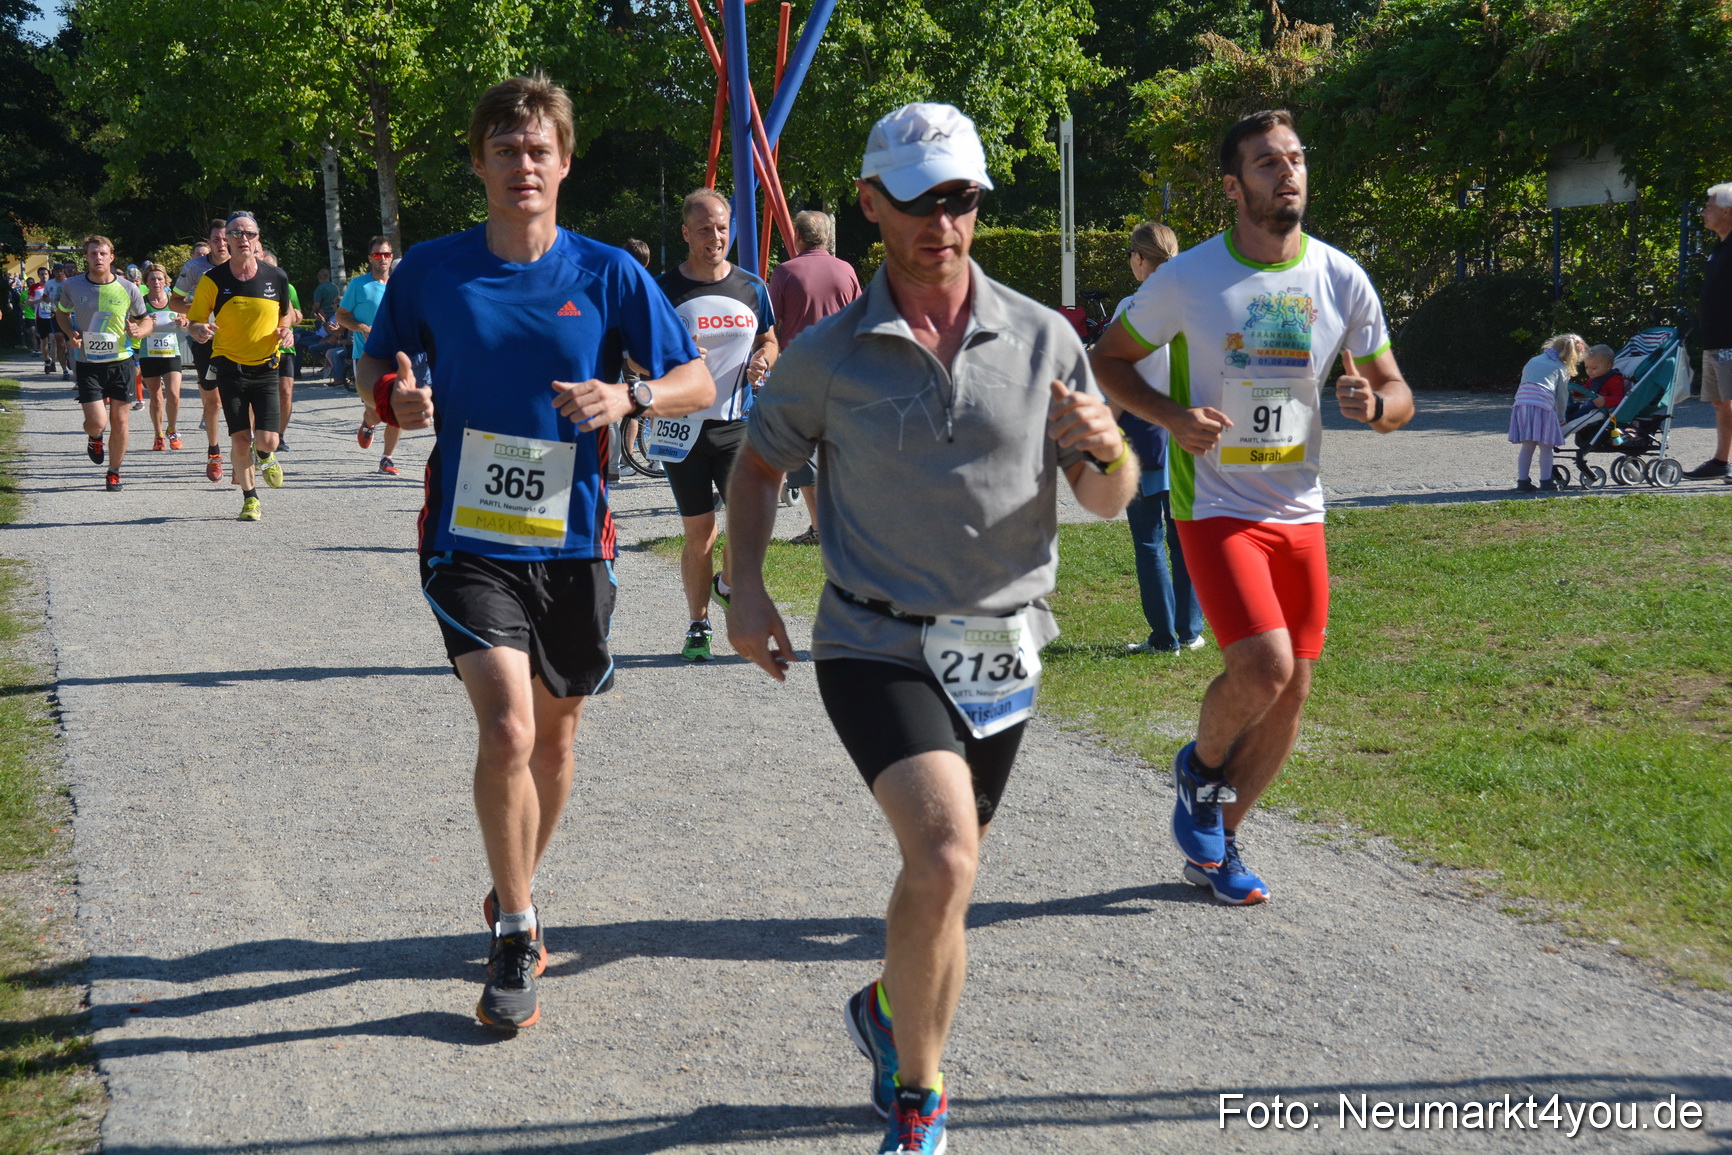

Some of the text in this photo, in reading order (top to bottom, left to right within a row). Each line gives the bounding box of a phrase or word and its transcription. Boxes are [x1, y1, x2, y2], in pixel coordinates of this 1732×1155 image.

[557, 305, 581, 316] adidas
[697, 314, 754, 329] BOSCH
[89, 340, 114, 351] 2220
[153, 339, 169, 347] 215
[1263, 340, 1306, 350] SCHWEIZ
[1256, 348, 1310, 358] MARATHON
[1252, 387, 1291, 398] BOCK
[1253, 405, 1283, 434] 91
[656, 419, 691, 442] 2598
[1239, 436, 1286, 444] PARTL Neumarkt
[494, 443, 543, 461] BOCK
[1250, 449, 1281, 463] Sarah
[484, 463, 545, 501] 365
[479, 498, 536, 513] PARTL Neumarkt
[475, 515, 538, 536] MARKUS
